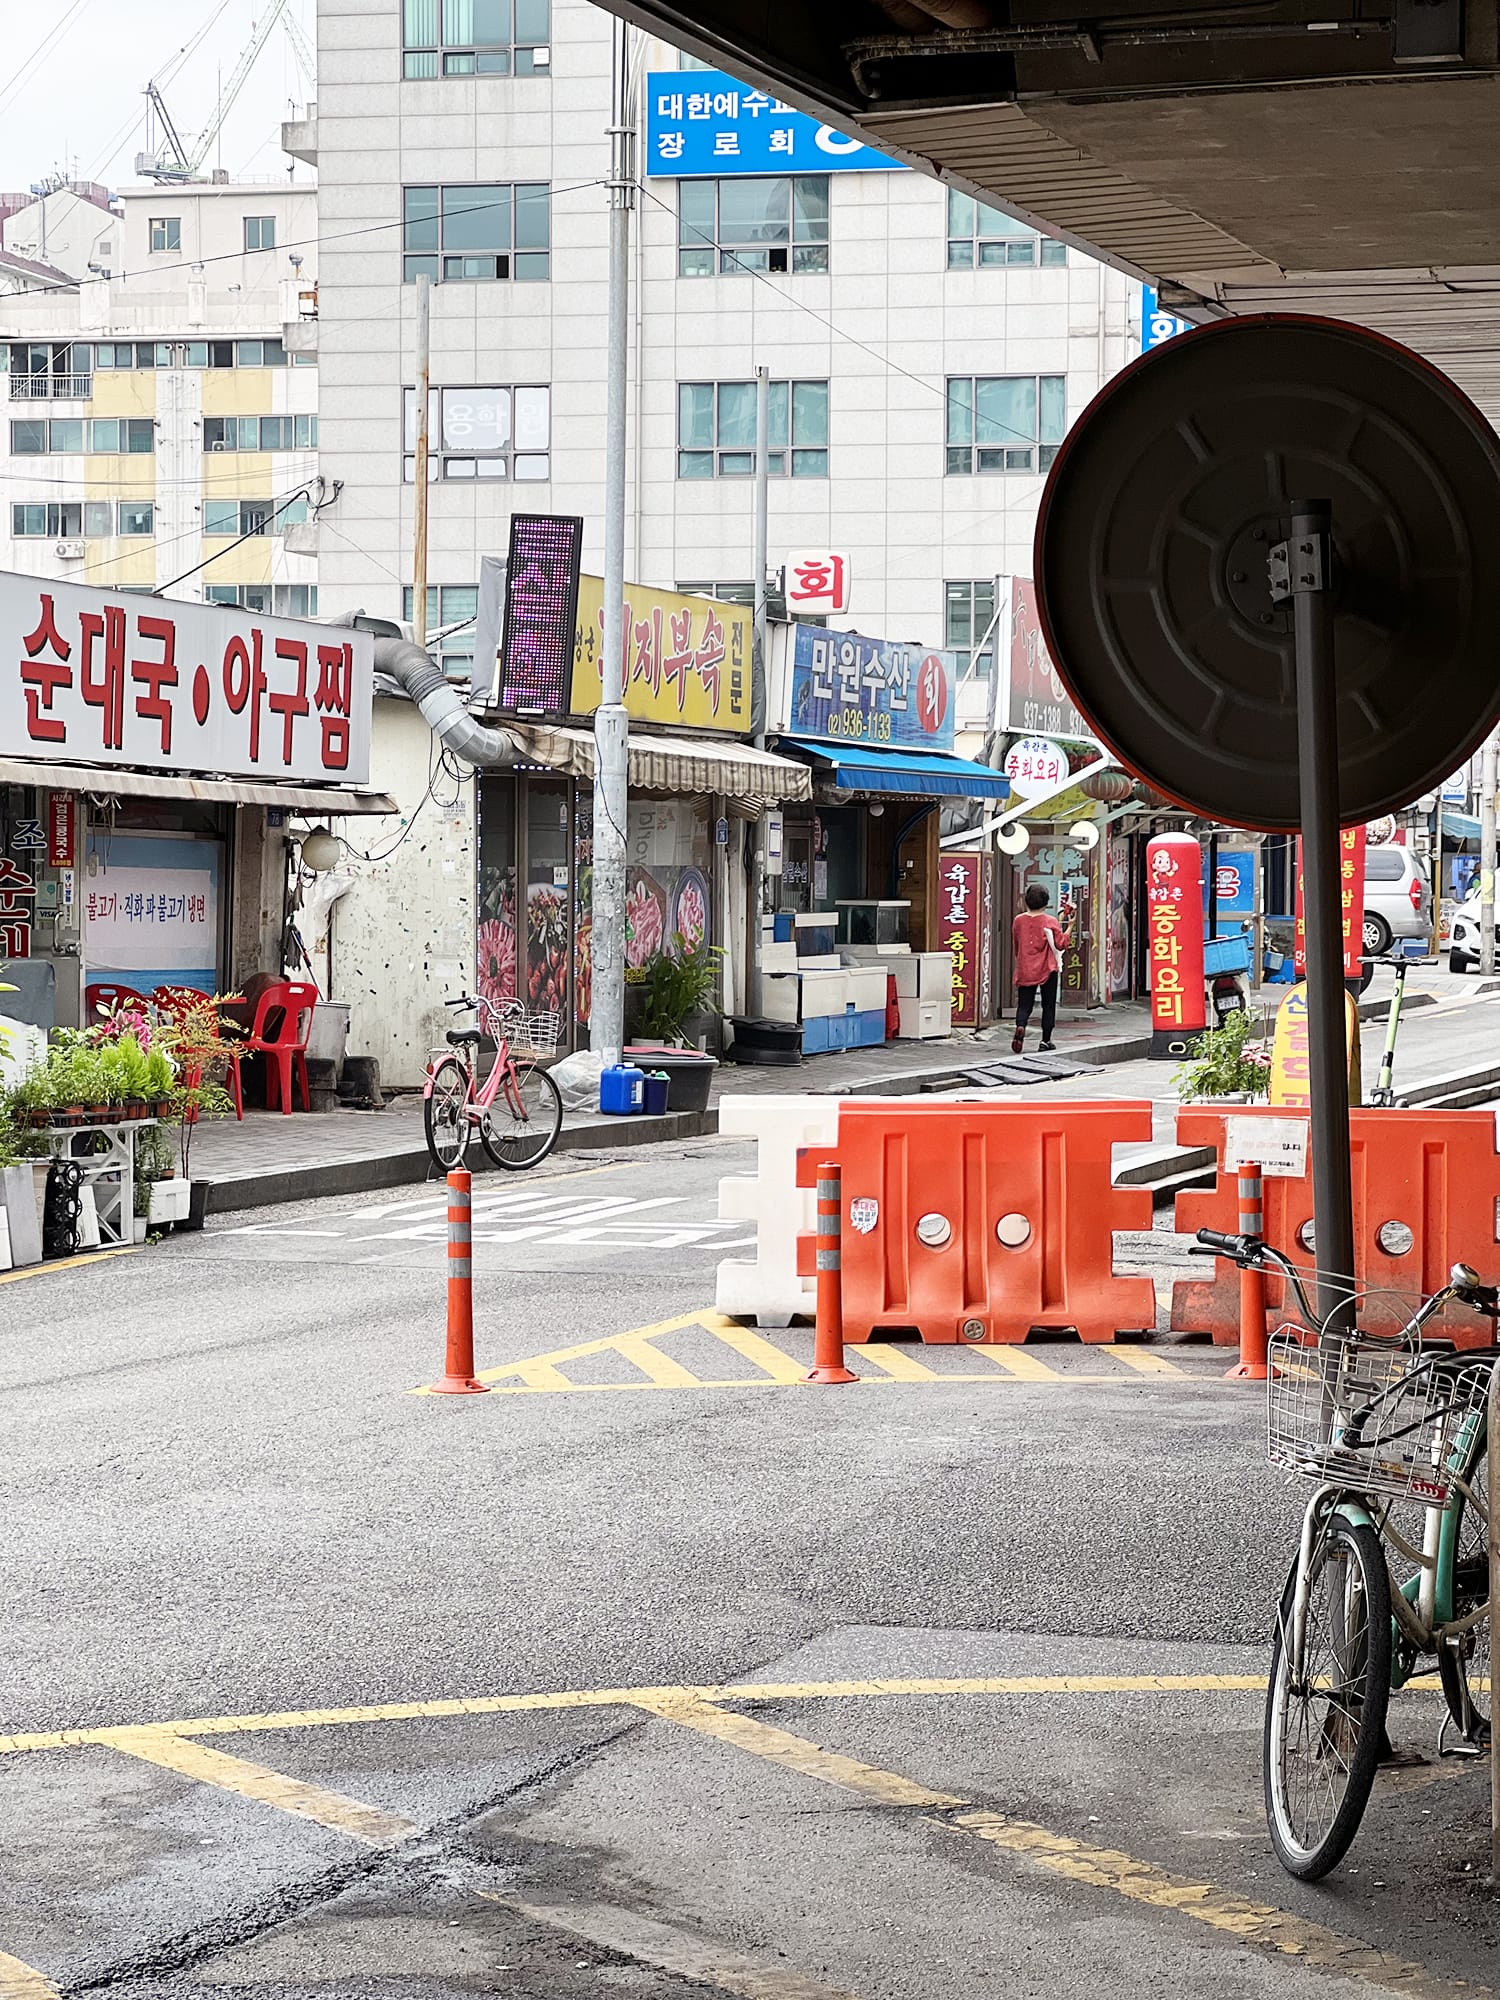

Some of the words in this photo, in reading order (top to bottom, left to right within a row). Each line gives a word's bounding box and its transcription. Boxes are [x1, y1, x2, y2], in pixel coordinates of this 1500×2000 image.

[790, 555, 843, 608] 회
[811, 639, 911, 711] 만원수산
[924, 657, 941, 727] 회
[843, 708, 892, 740] 936-1133
[1008, 755, 1059, 784] 중화요리
[86, 892, 117, 922] 불고기
[187, 895, 205, 922] 냉면
[943, 931, 969, 1012] 중화요리
[1151, 904, 1184, 1024] 중화요리
